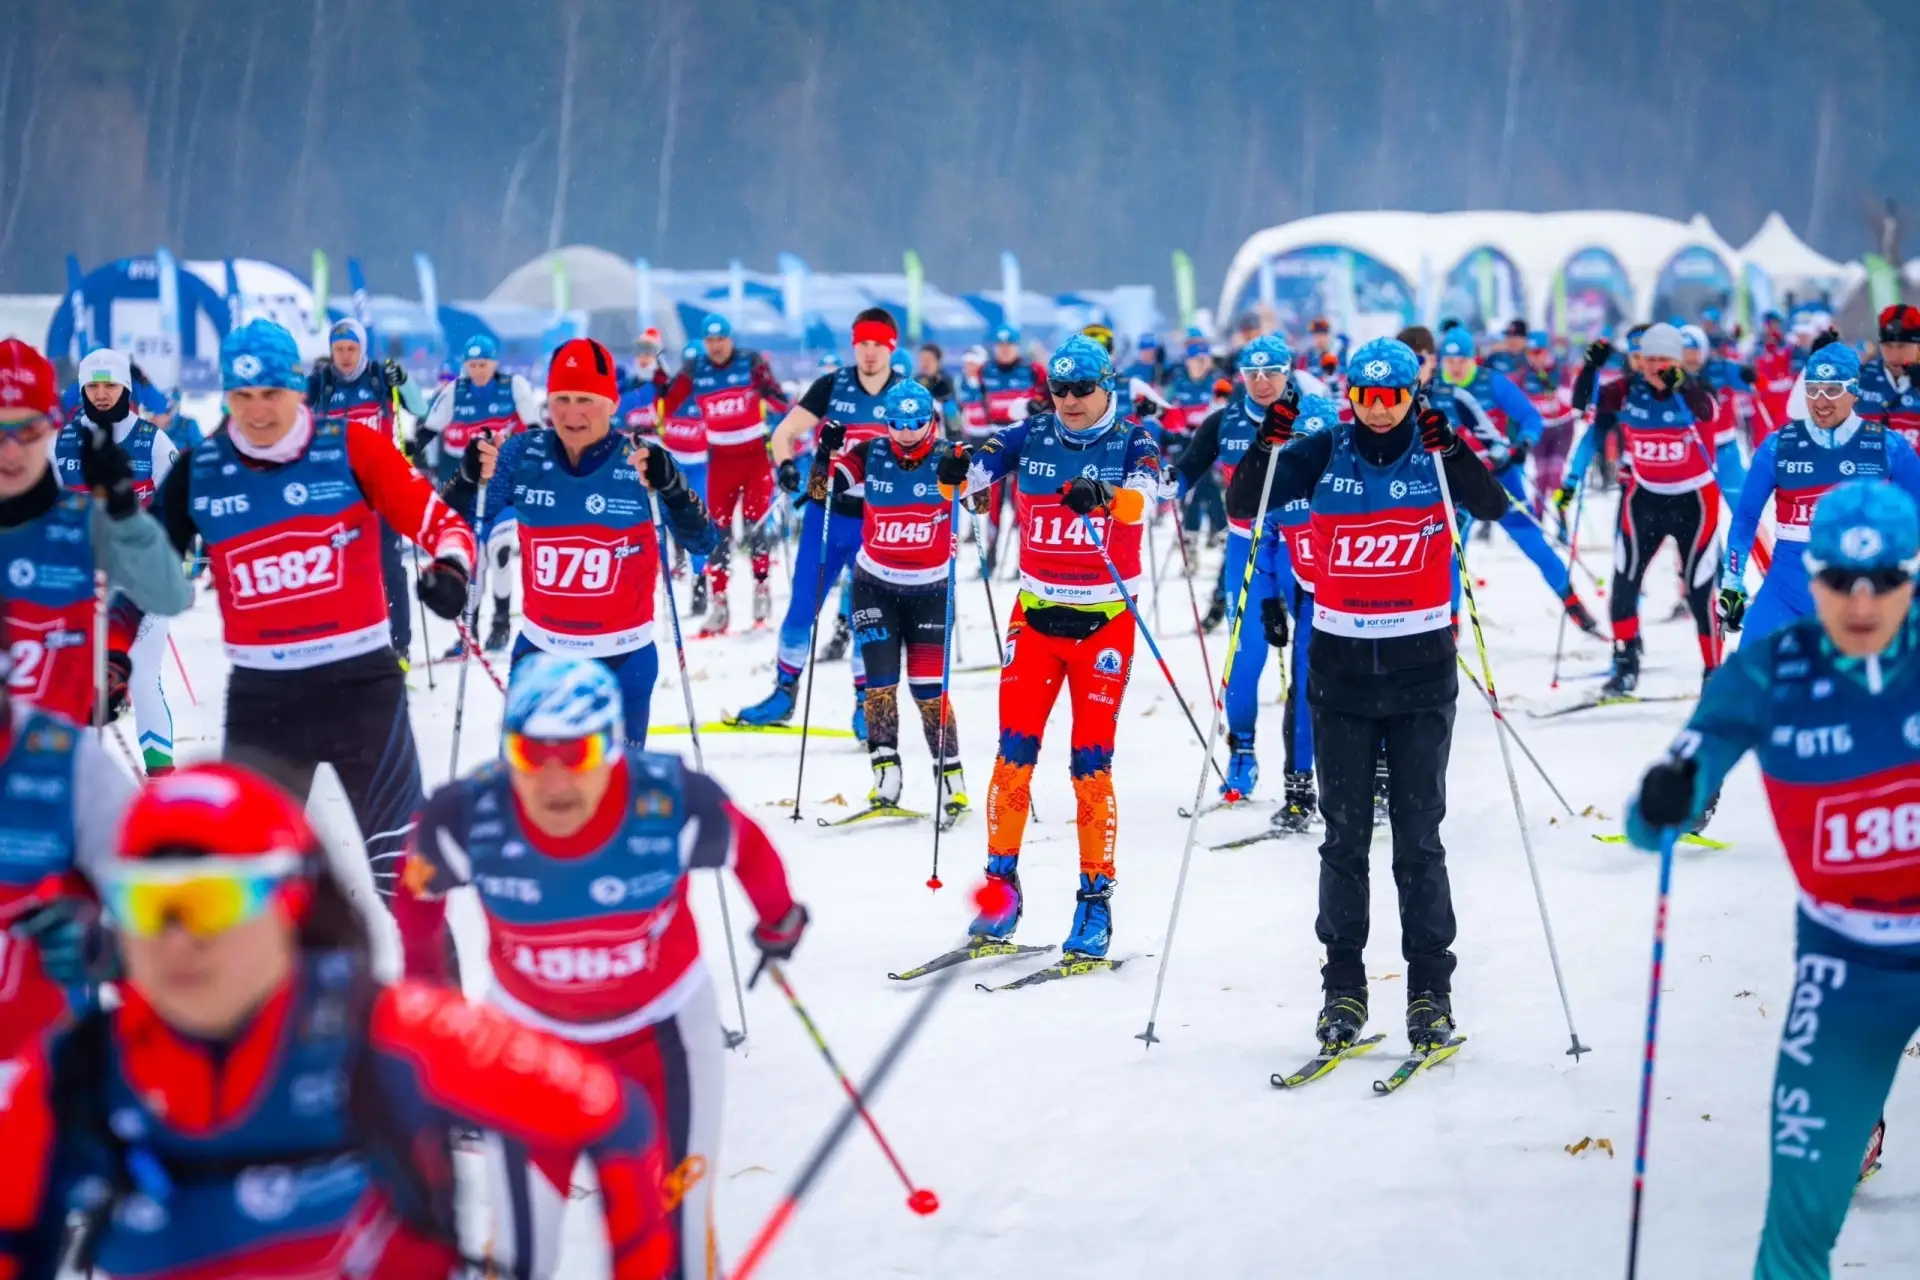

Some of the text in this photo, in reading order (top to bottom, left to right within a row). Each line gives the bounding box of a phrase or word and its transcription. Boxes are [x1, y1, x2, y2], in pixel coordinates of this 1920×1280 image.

[1227, 439, 1249, 450] ВТБ
[1633, 440, 1685, 461] 1213
[1028, 461, 1057, 477] ВТБ
[1786, 461, 1814, 473] ВТБ
[872, 480, 894, 493] ВТБ
[1332, 477, 1364, 495] ВТБ
[210, 494, 250, 517] ВТБ
[524, 489, 555, 507] ВТБ
[1284, 498, 1310, 512] ВТБ
[876, 521, 932, 544] 1045
[1030, 515, 1106, 546] 1146
[1334, 532, 1421, 567] 1227
[232, 545, 335, 598] 1582
[536, 545, 611, 589] 979
[1056, 588, 1092, 596] ЮГОРИЯ
[1367, 617, 1405, 626] ЮГОРИЯ
[1796, 724, 1853, 758] ВТБ
[1780, 953, 1847, 1066] Easy
